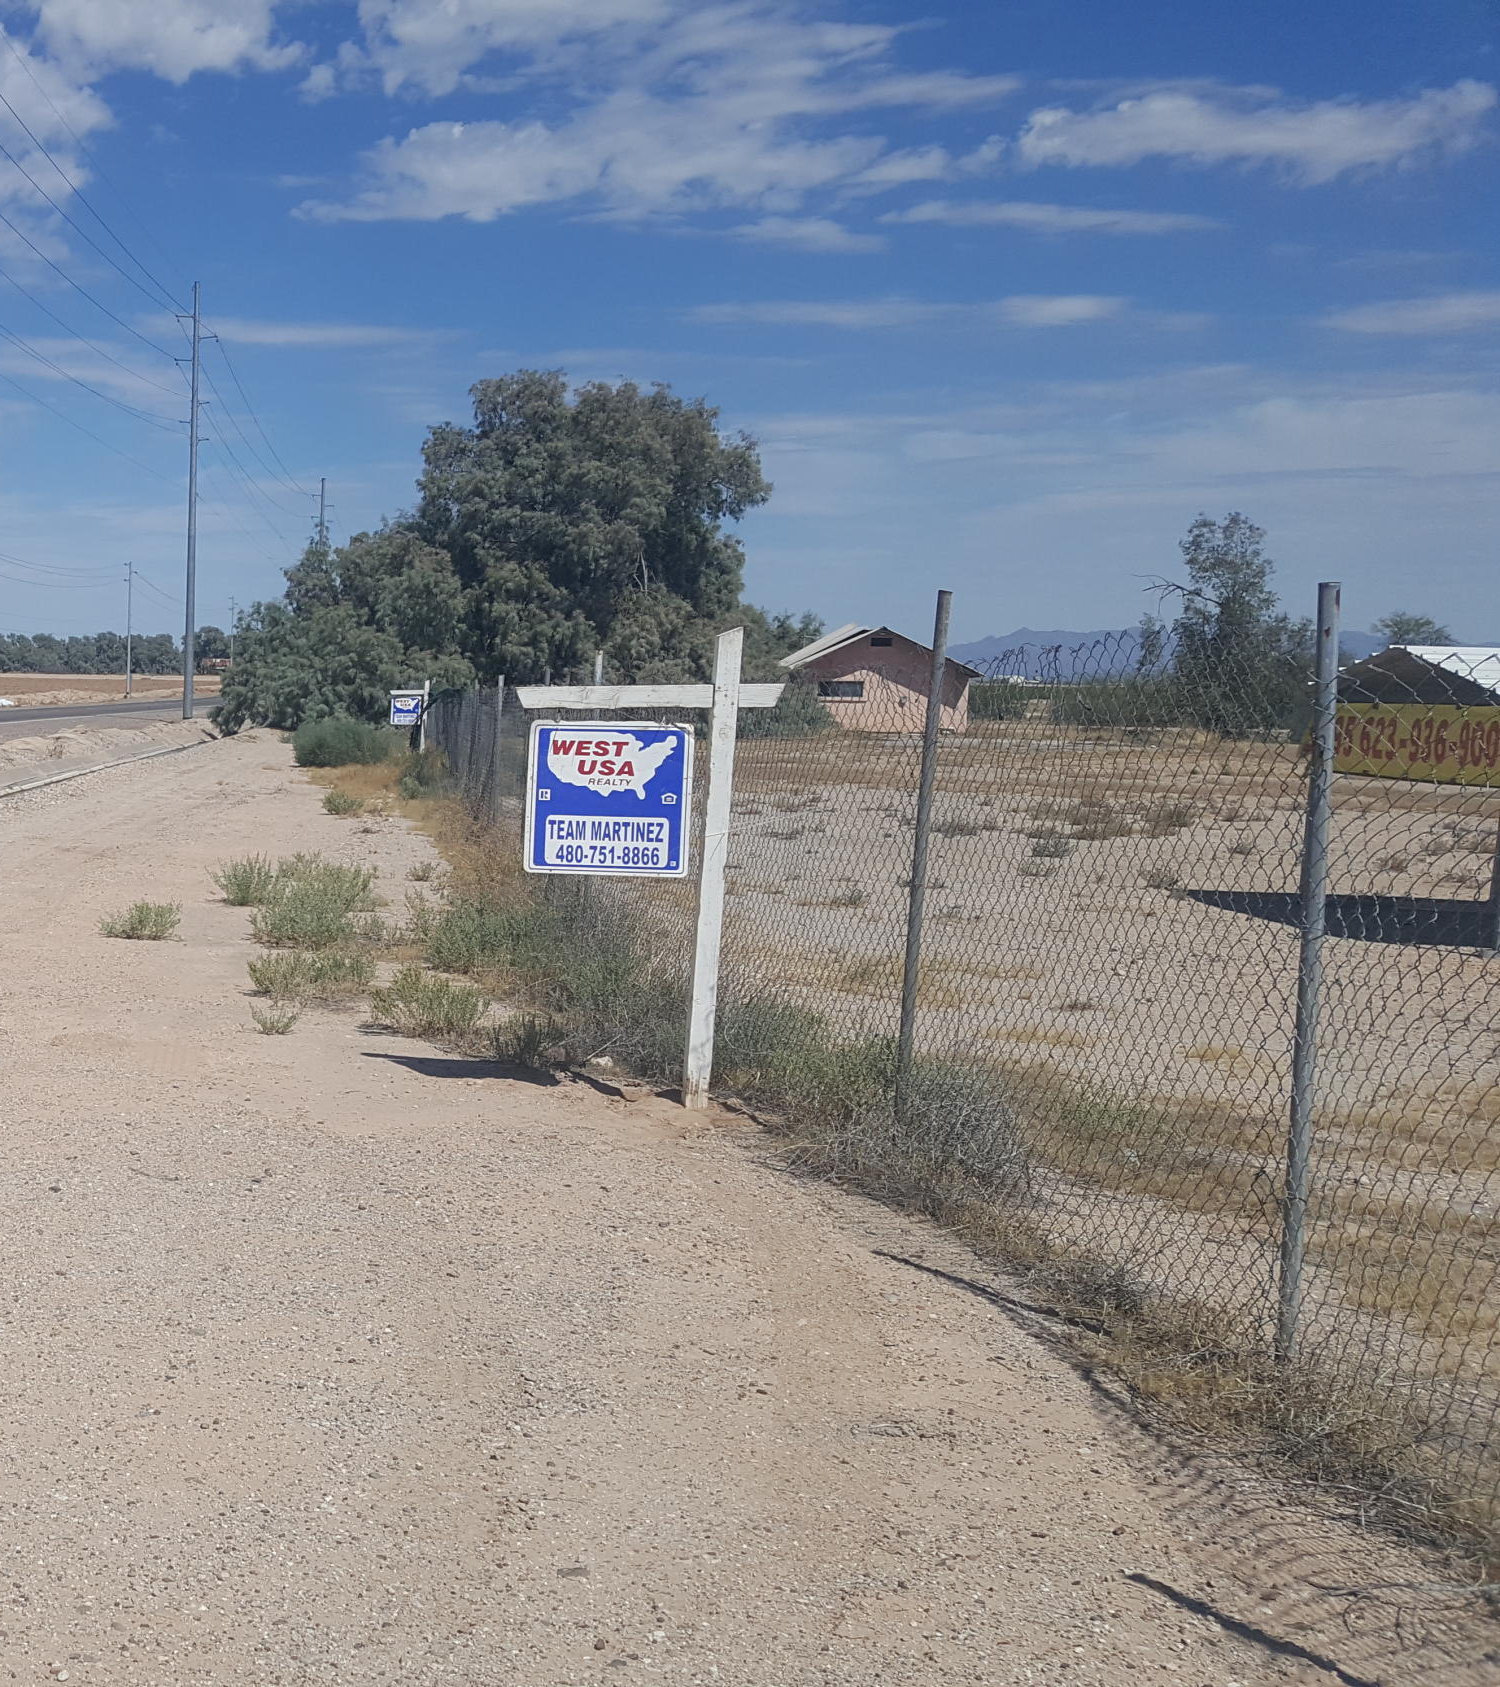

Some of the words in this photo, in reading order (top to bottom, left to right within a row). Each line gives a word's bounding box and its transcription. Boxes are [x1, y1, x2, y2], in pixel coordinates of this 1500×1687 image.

[552, 740, 629, 757] WEST
[578, 760, 635, 777] USA
[588, 778, 632, 787] REALTY
[548, 820, 587, 841] TEAM
[591, 821, 664, 843] MARTINEZ
[556, 844, 660, 866] 480-751-8866
